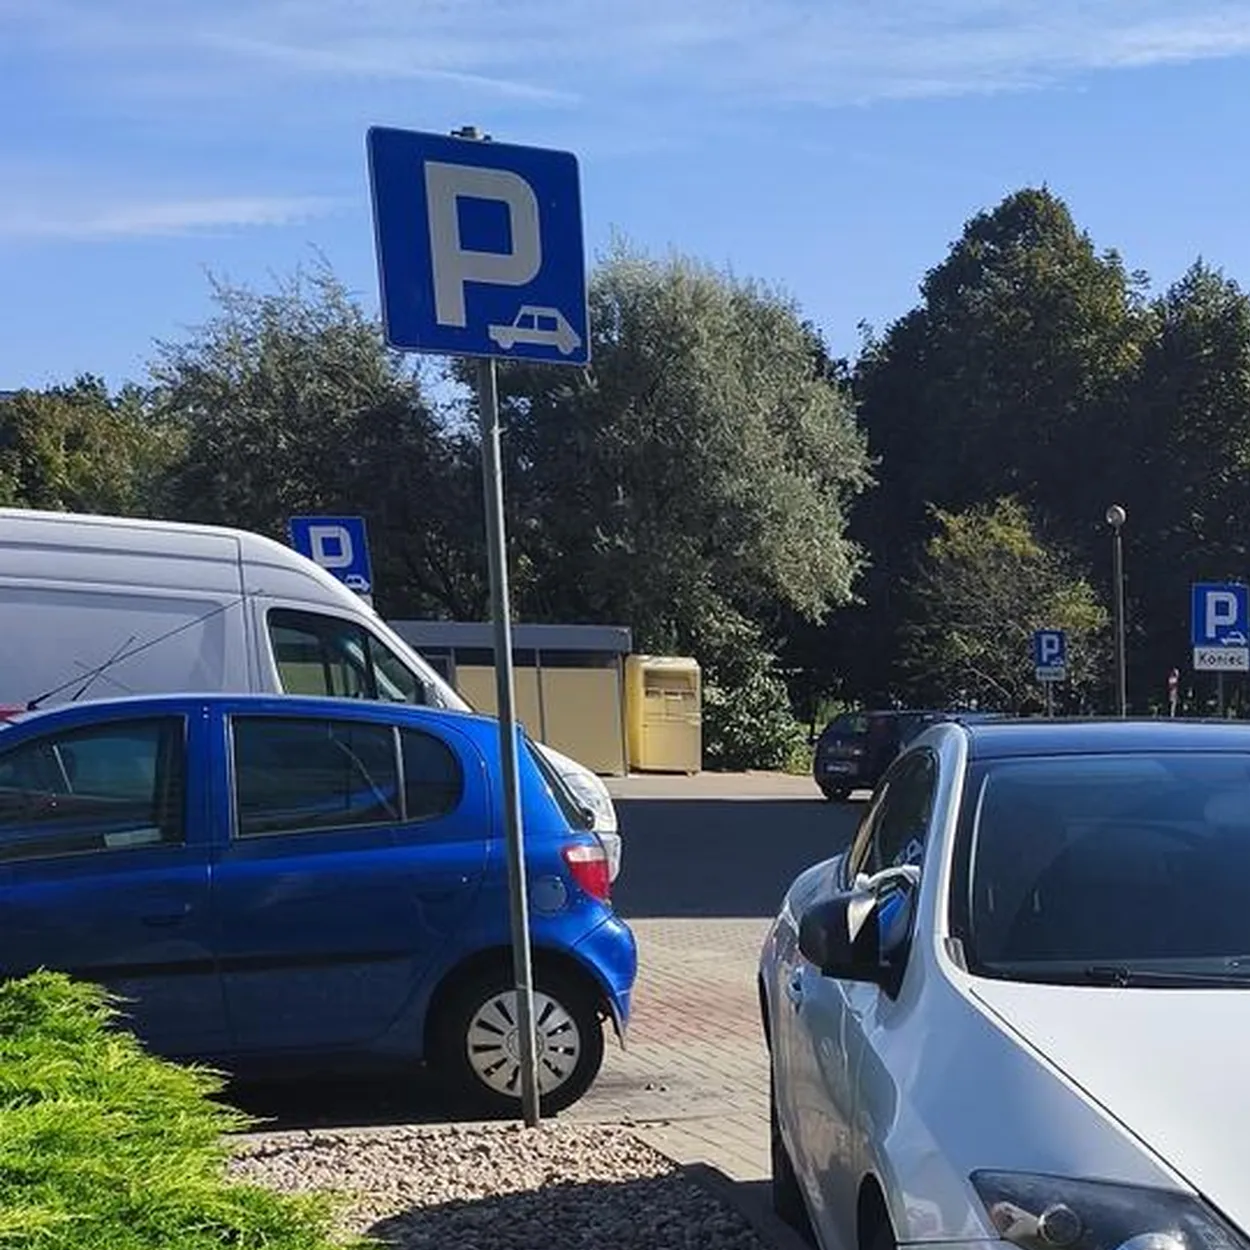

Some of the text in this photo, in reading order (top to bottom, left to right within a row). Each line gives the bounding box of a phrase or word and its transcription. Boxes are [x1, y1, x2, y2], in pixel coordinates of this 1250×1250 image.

[424, 161, 542, 327] P
[1205, 592, 1238, 638] P
[1041, 634, 1060, 663] P
[1199, 649, 1244, 666] Koniec
